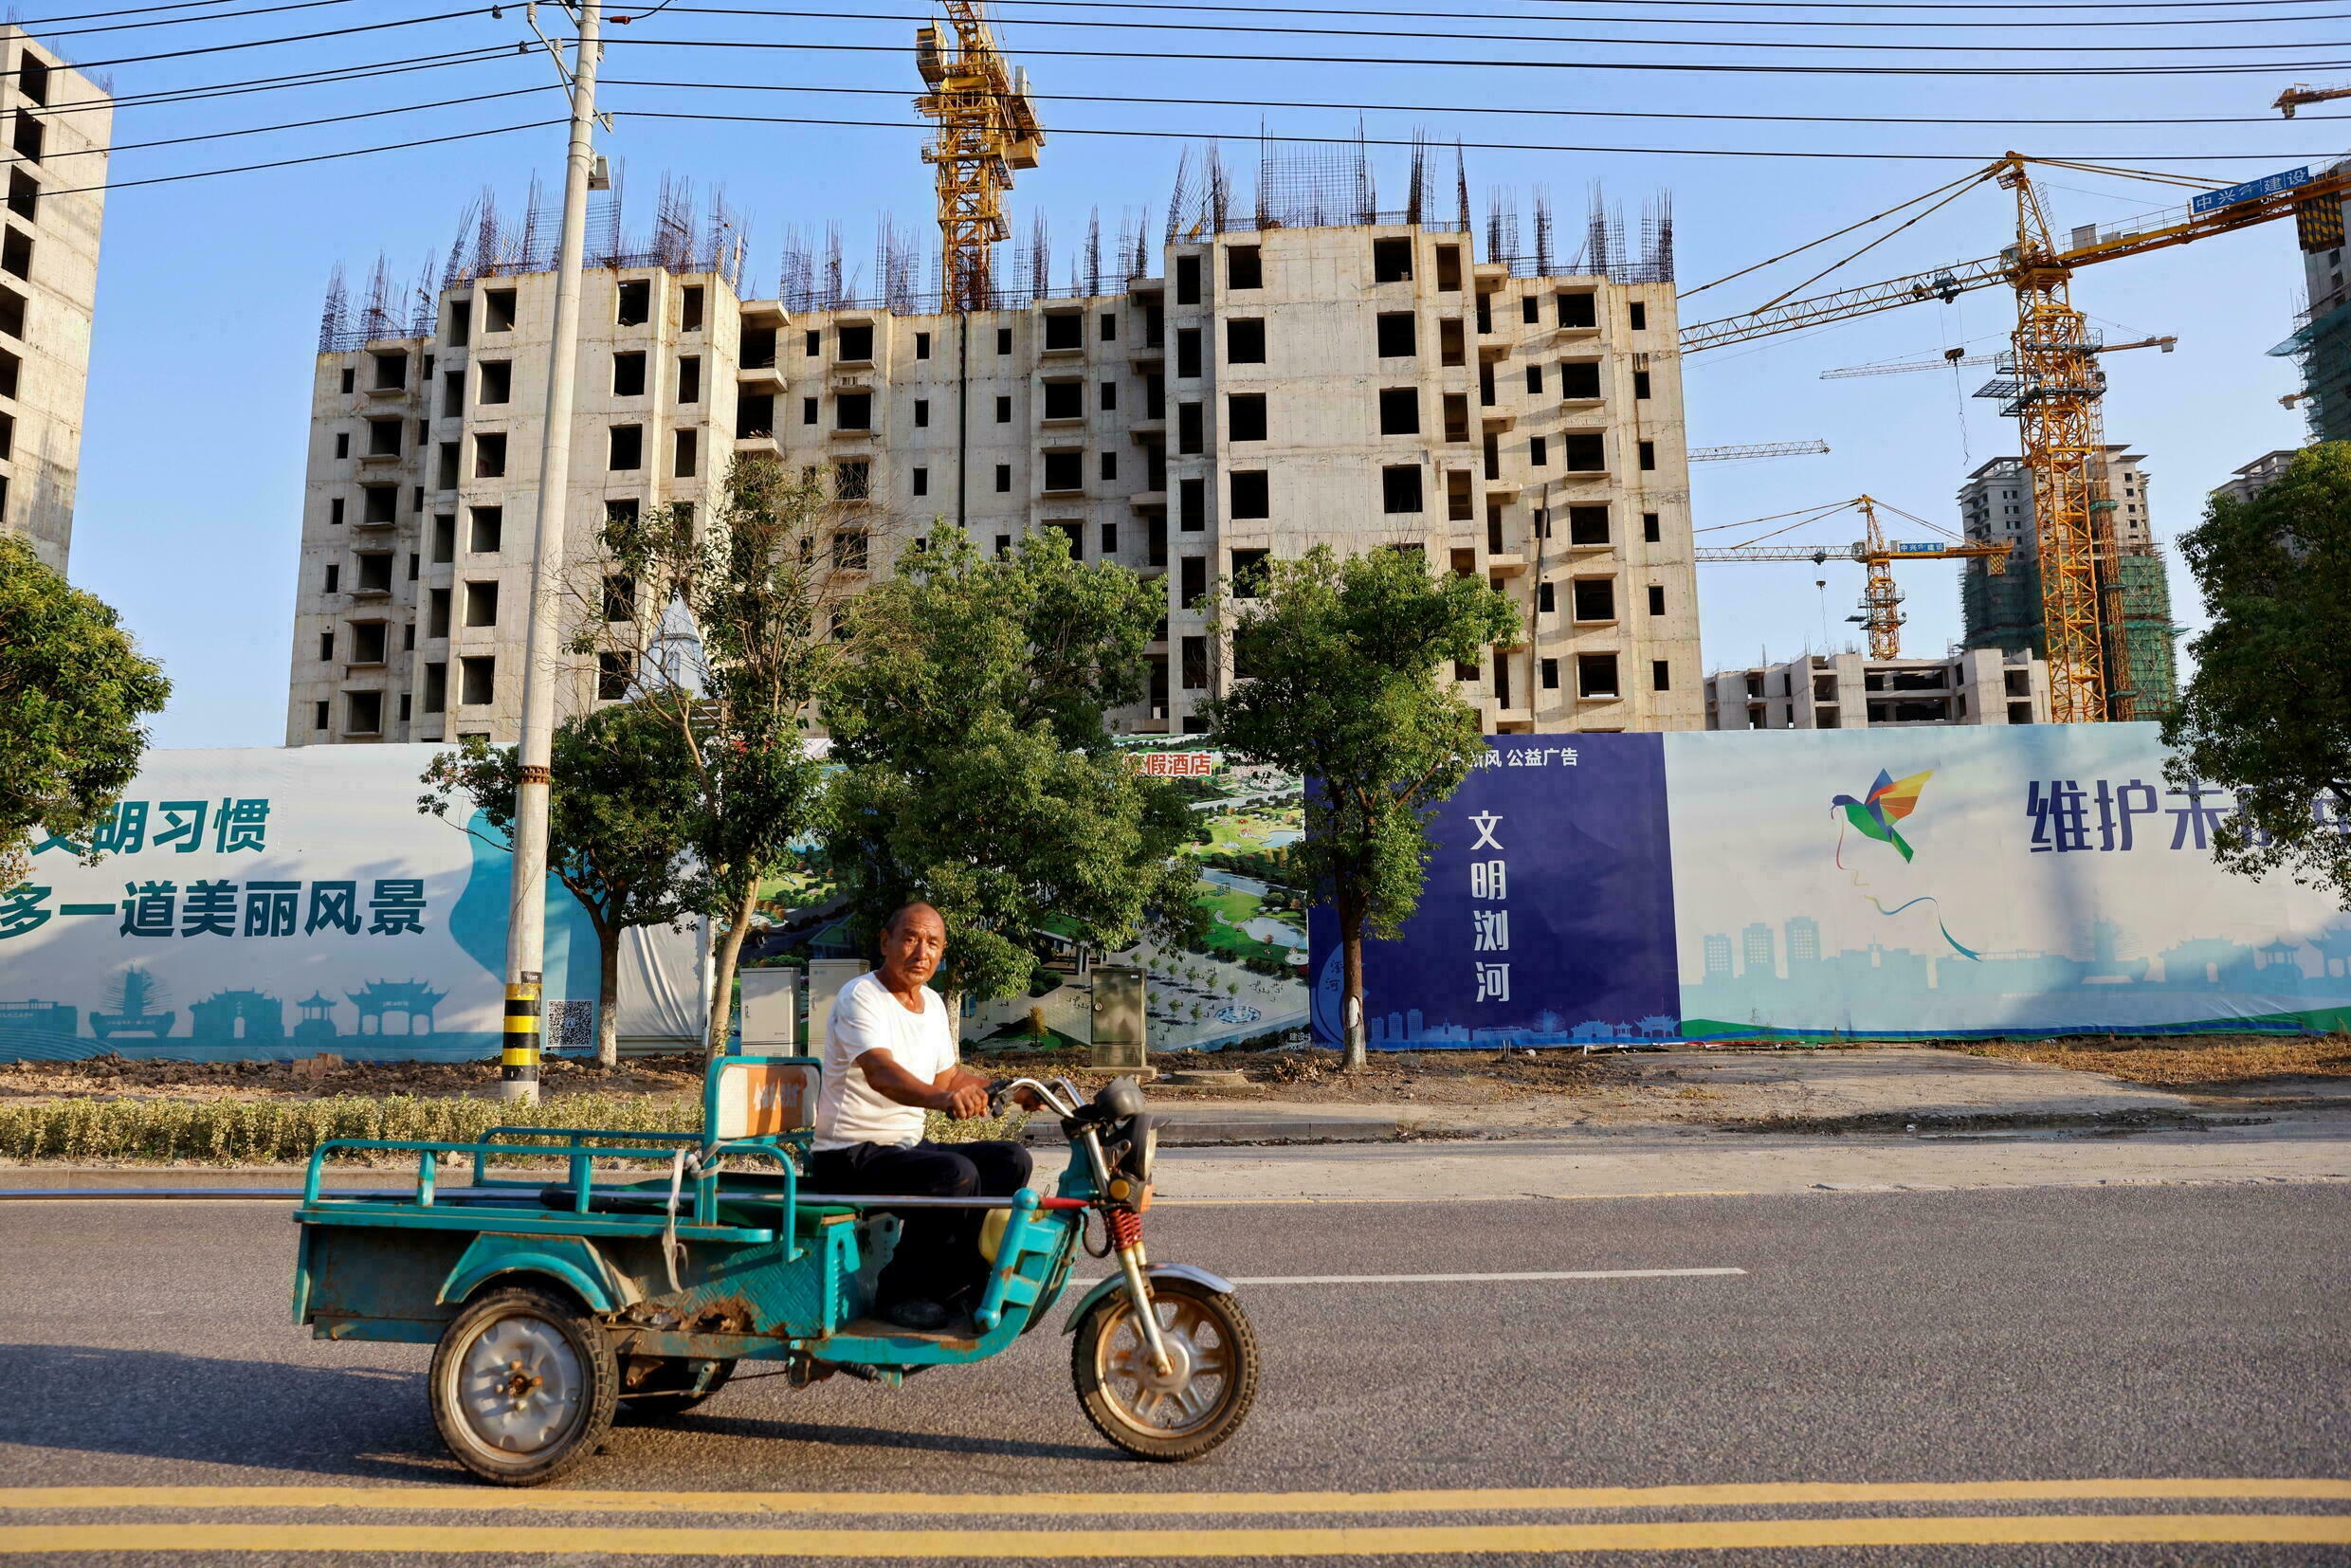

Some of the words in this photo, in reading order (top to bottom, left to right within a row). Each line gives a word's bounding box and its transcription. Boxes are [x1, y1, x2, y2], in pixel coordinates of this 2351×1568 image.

[1124, 753, 1212, 775] 假酒店
[1506, 747, 1578, 767] 公益广告
[0, 879, 428, 939] 多一道美丽风景
[1467, 810, 1510, 1003] 文明浏河
